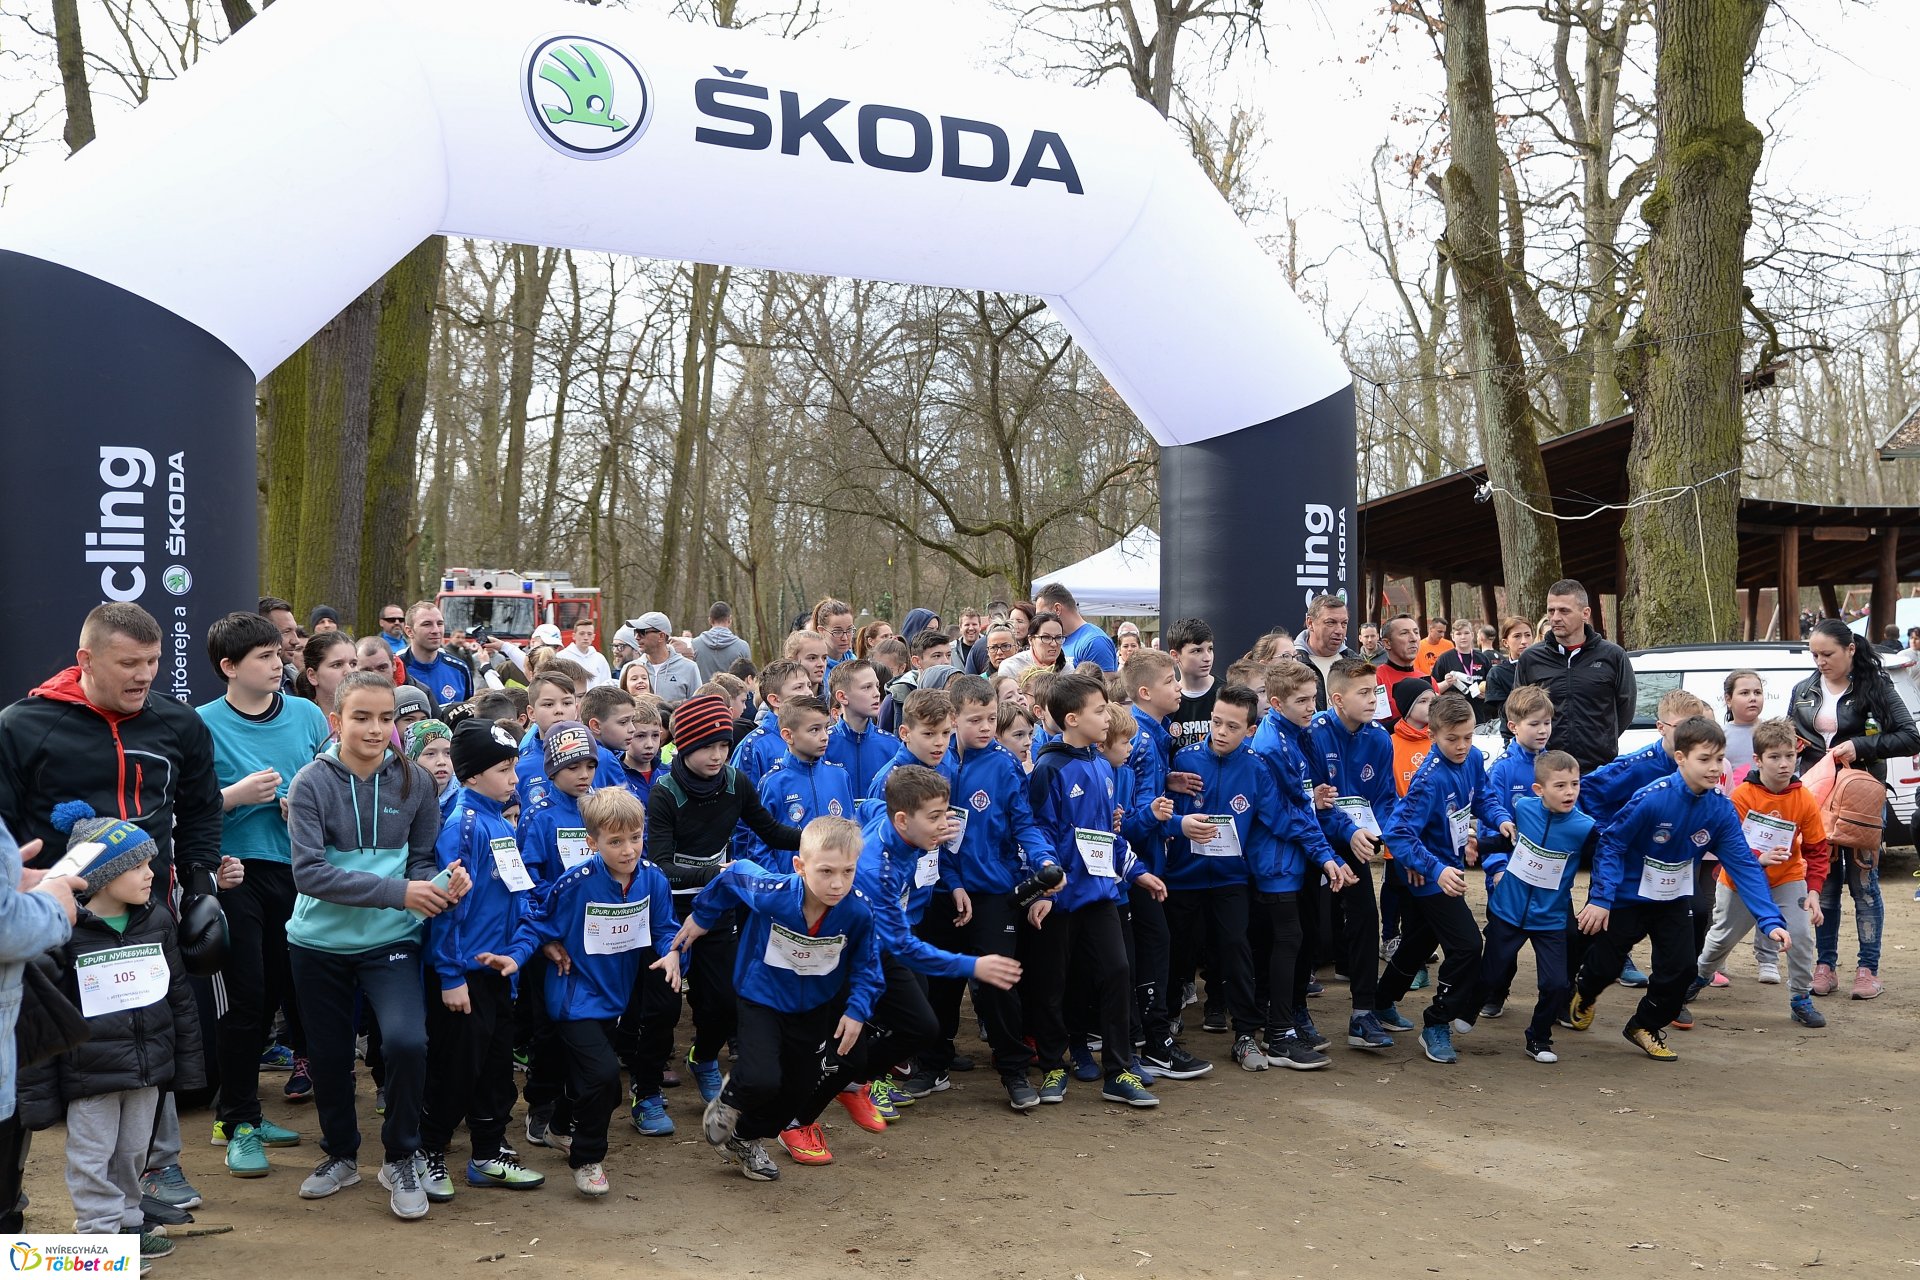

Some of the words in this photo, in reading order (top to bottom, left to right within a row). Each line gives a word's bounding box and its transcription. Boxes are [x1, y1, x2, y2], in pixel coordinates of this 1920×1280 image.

[695, 65, 1085, 196] ŠKODA
[165, 450, 186, 556] ŠKODA
[86, 446, 156, 605] cling
[1337, 507, 1346, 581] ŠKODA
[174, 606, 187, 617] a
[1090, 849, 1104, 859] 208
[1527, 859, 1543, 871] 279
[590, 908, 612, 916] SPURI
[611, 924, 629, 935] 110
[83, 955, 107, 967] SPURI
[109, 947, 158, 961] NYÍREGYHÁZA
[791, 949, 811, 959] 203
[113, 971, 136, 984] 105
